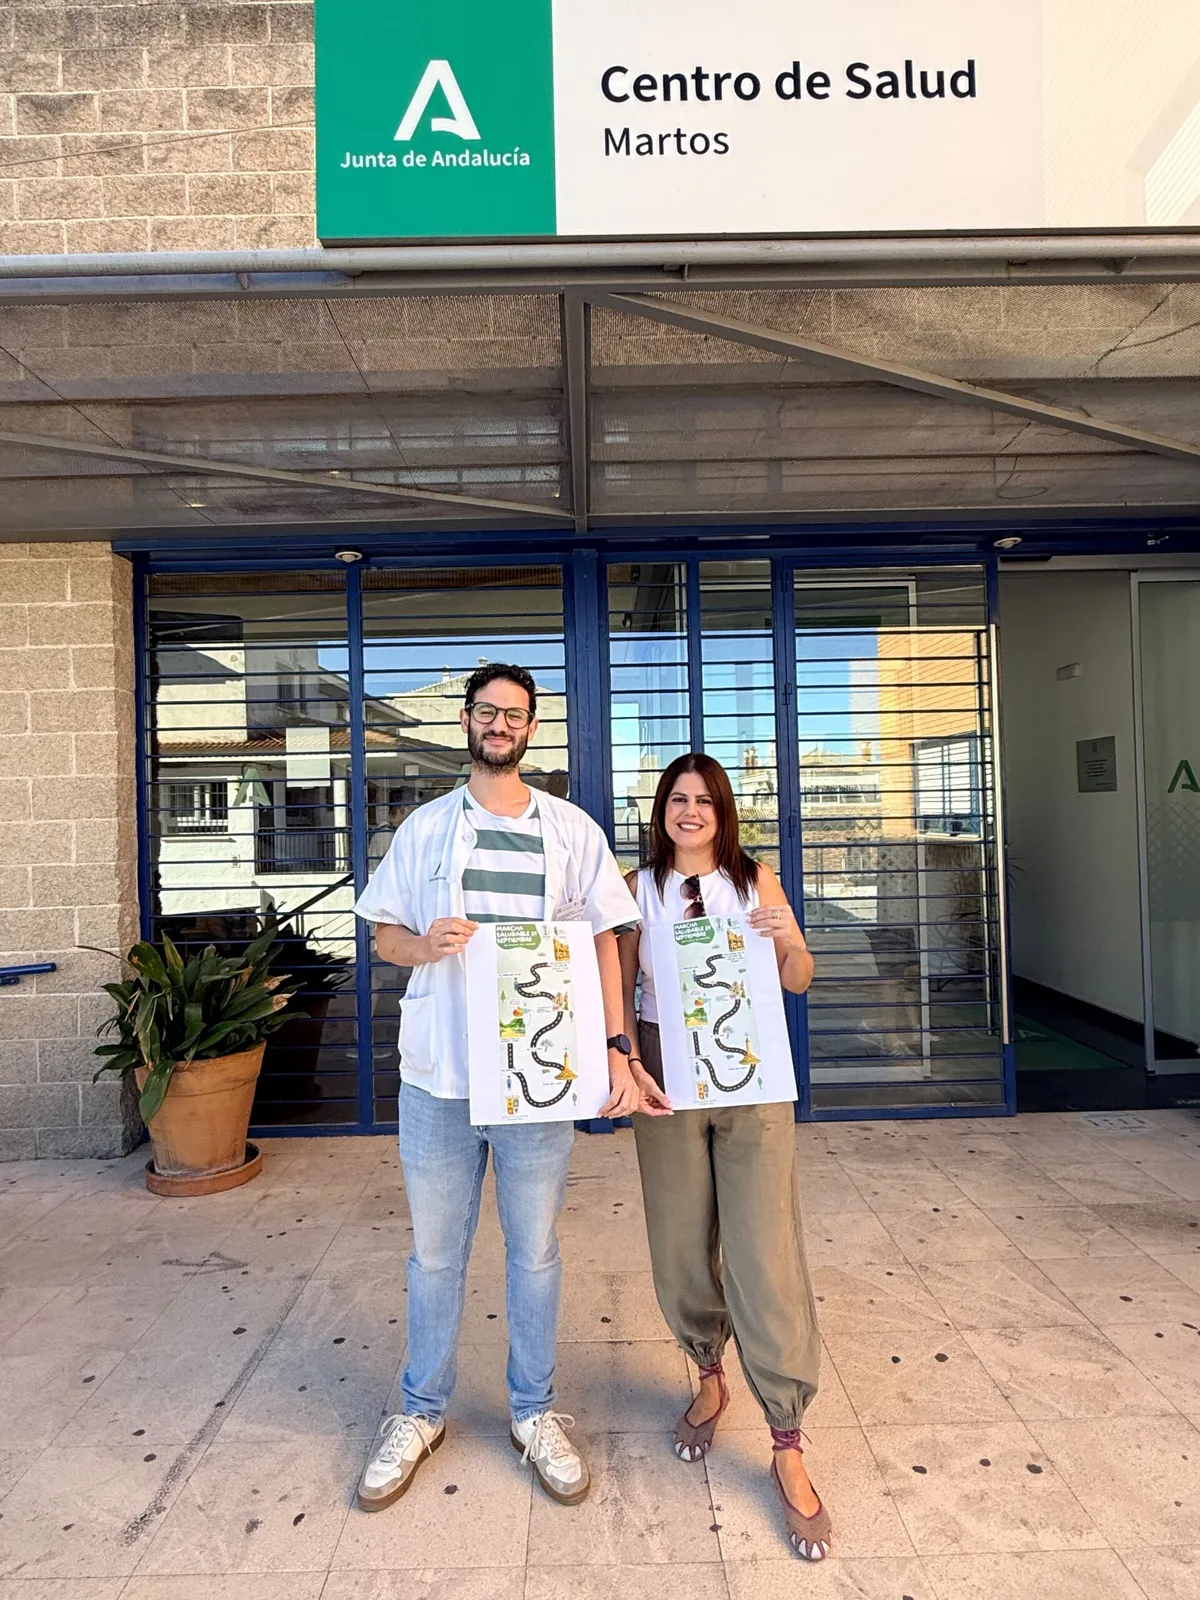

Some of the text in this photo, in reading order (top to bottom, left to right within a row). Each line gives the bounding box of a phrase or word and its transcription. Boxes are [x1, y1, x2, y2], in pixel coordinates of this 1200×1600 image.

[600, 59, 977, 104] Centro de Salud
[603, 127, 730, 157] Martos
[340, 146, 531, 169] Junta de Andalucía
[674, 921, 698, 930] MARCHA
[674, 926, 704, 936] SALUDABLE
